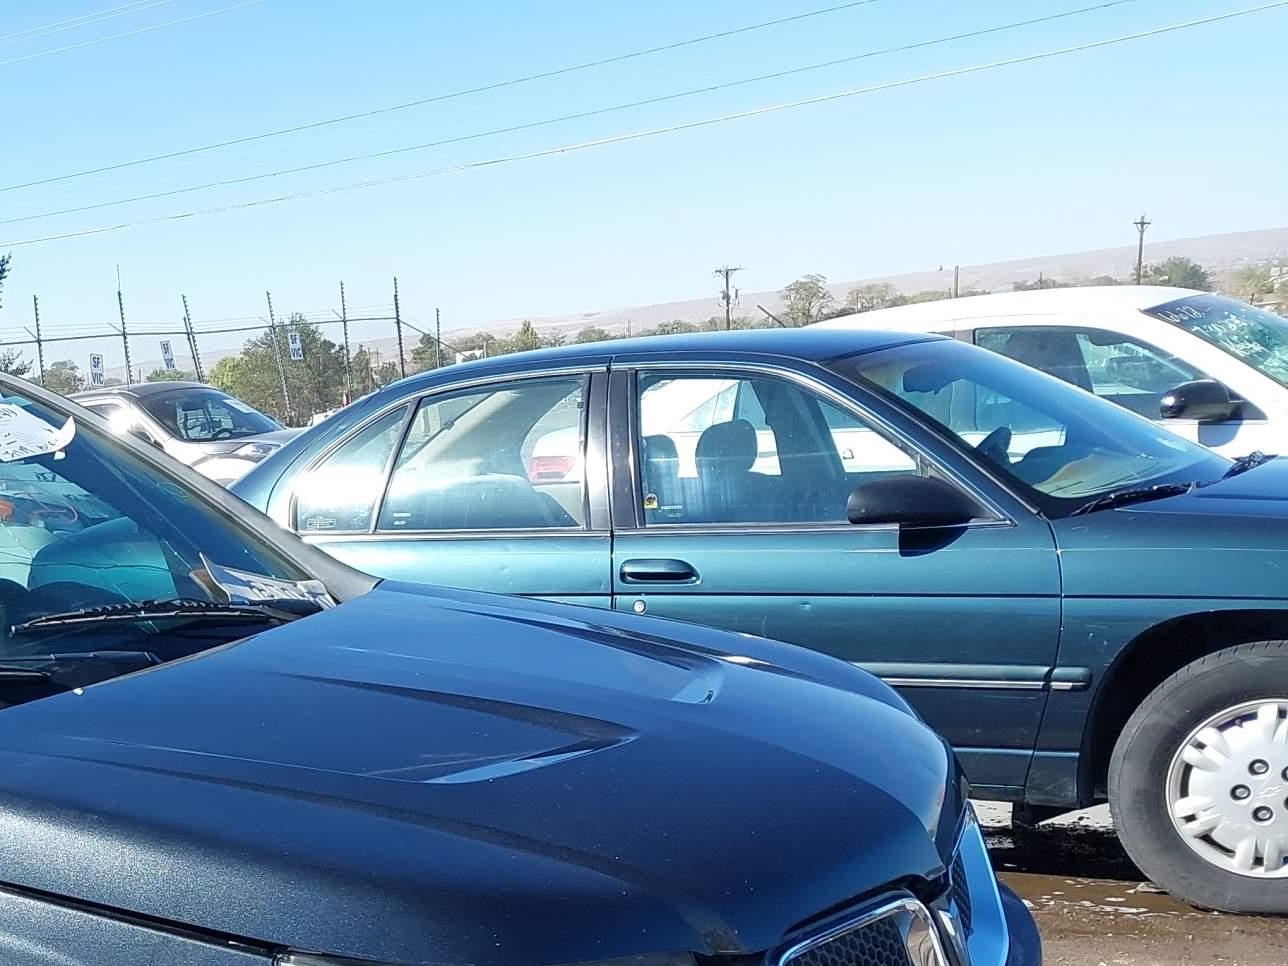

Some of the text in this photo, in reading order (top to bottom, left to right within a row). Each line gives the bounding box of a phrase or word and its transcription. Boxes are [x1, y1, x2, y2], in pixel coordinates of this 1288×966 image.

[162, 343, 170, 354] SF
[92, 356, 100, 368] SF
[92, 372, 104, 385] VIC
